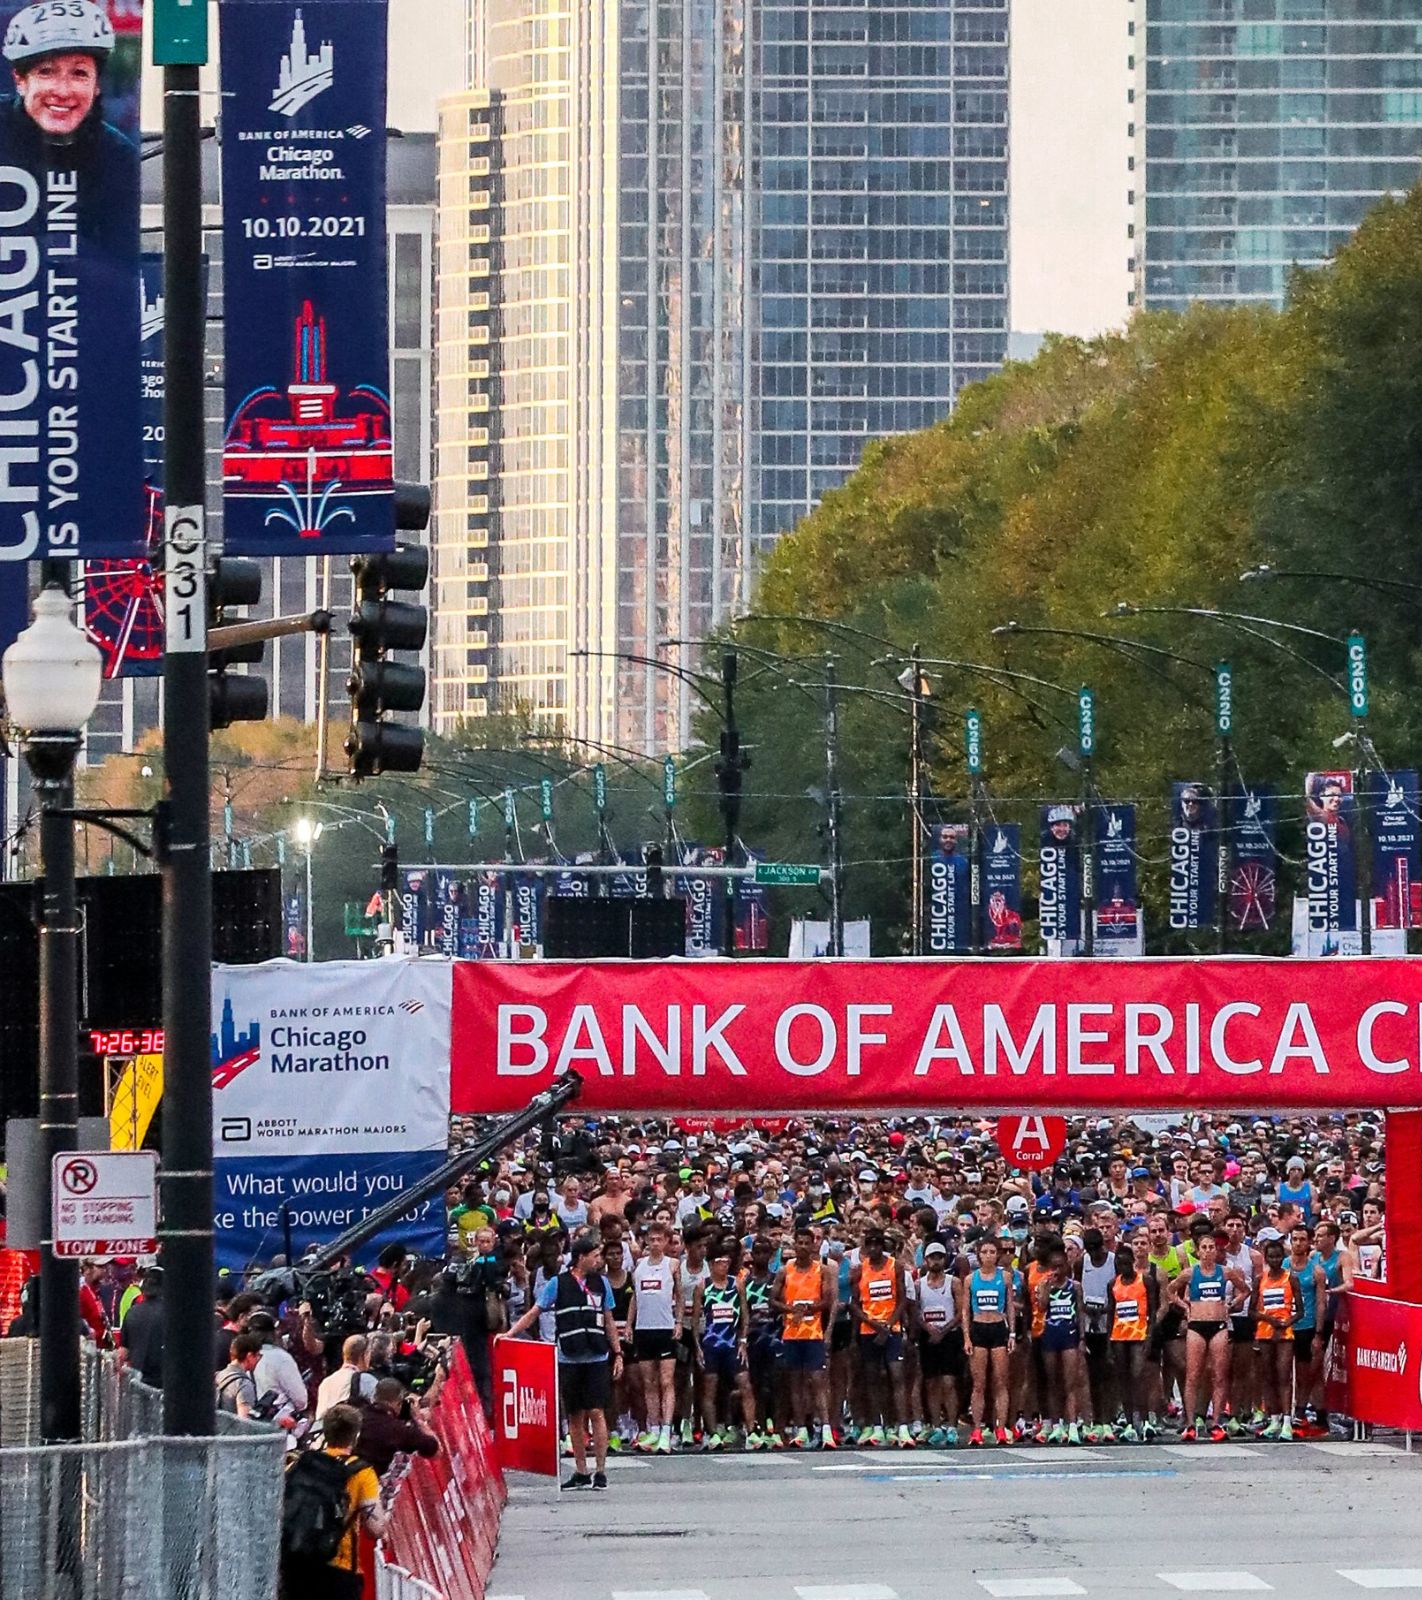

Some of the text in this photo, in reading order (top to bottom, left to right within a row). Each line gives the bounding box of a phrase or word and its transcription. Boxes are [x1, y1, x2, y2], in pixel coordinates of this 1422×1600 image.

[238, 130, 344, 140] BANK OF AMERICA
[267, 146, 334, 166] Chicago
[241, 217, 365, 239] 10.10.2021
[0, 166, 40, 561] CHICAGO
[47, 170, 79, 557] IS YOUR START LINE
[170, 517, 199, 640] C31
[1350, 645, 1365, 708] C200
[1218, 672, 1232, 730] C220
[967, 718, 979, 767] C260
[1080, 696, 1092, 749] C240
[764, 866, 806, 876] JACKSON
[1170, 828, 1191, 929] CHICAGO
[1307, 821, 1326, 932] CHICAGO
[1329, 823, 1339, 935] IS YOUR START LINE
[931, 862, 947, 950] CHICAGO
[1040, 847, 1057, 940] CHICAGO
[1057, 848, 1066, 942] IS YOUR START LINE
[479, 885, 490, 944] CHICAGO
[520, 886, 531, 946] CHICAGO
[691, 879, 706, 950] CHICAGO
[270, 1006, 395, 1018] BANK OF AMERICA
[270, 1027, 367, 1051] Chicago
[498, 1003, 748, 1076] BANK
[774, 1003, 893, 1075] OF
[913, 1002, 1329, 1075] AMERICA
[271, 1053, 389, 1073] Marathon
[257, 1119, 297, 1127] ABBOTT
[257, 1125, 407, 1137] WORLD MARATHON MAJORS
[1012, 1116, 1051, 1150] A
[1016, 1151, 1044, 1161] Corral
[226, 1170, 404, 1198] What would you
[83, 1201, 134, 1213] STOPPING
[83, 1213, 134, 1225] STANDING
[242, 1206, 278, 1229] the
[63, 1240, 148, 1255] TOW ZONE
[1357, 1347, 1398, 1373] BANK OF AMERICA
[519, 1387, 547, 1427] Abbott
